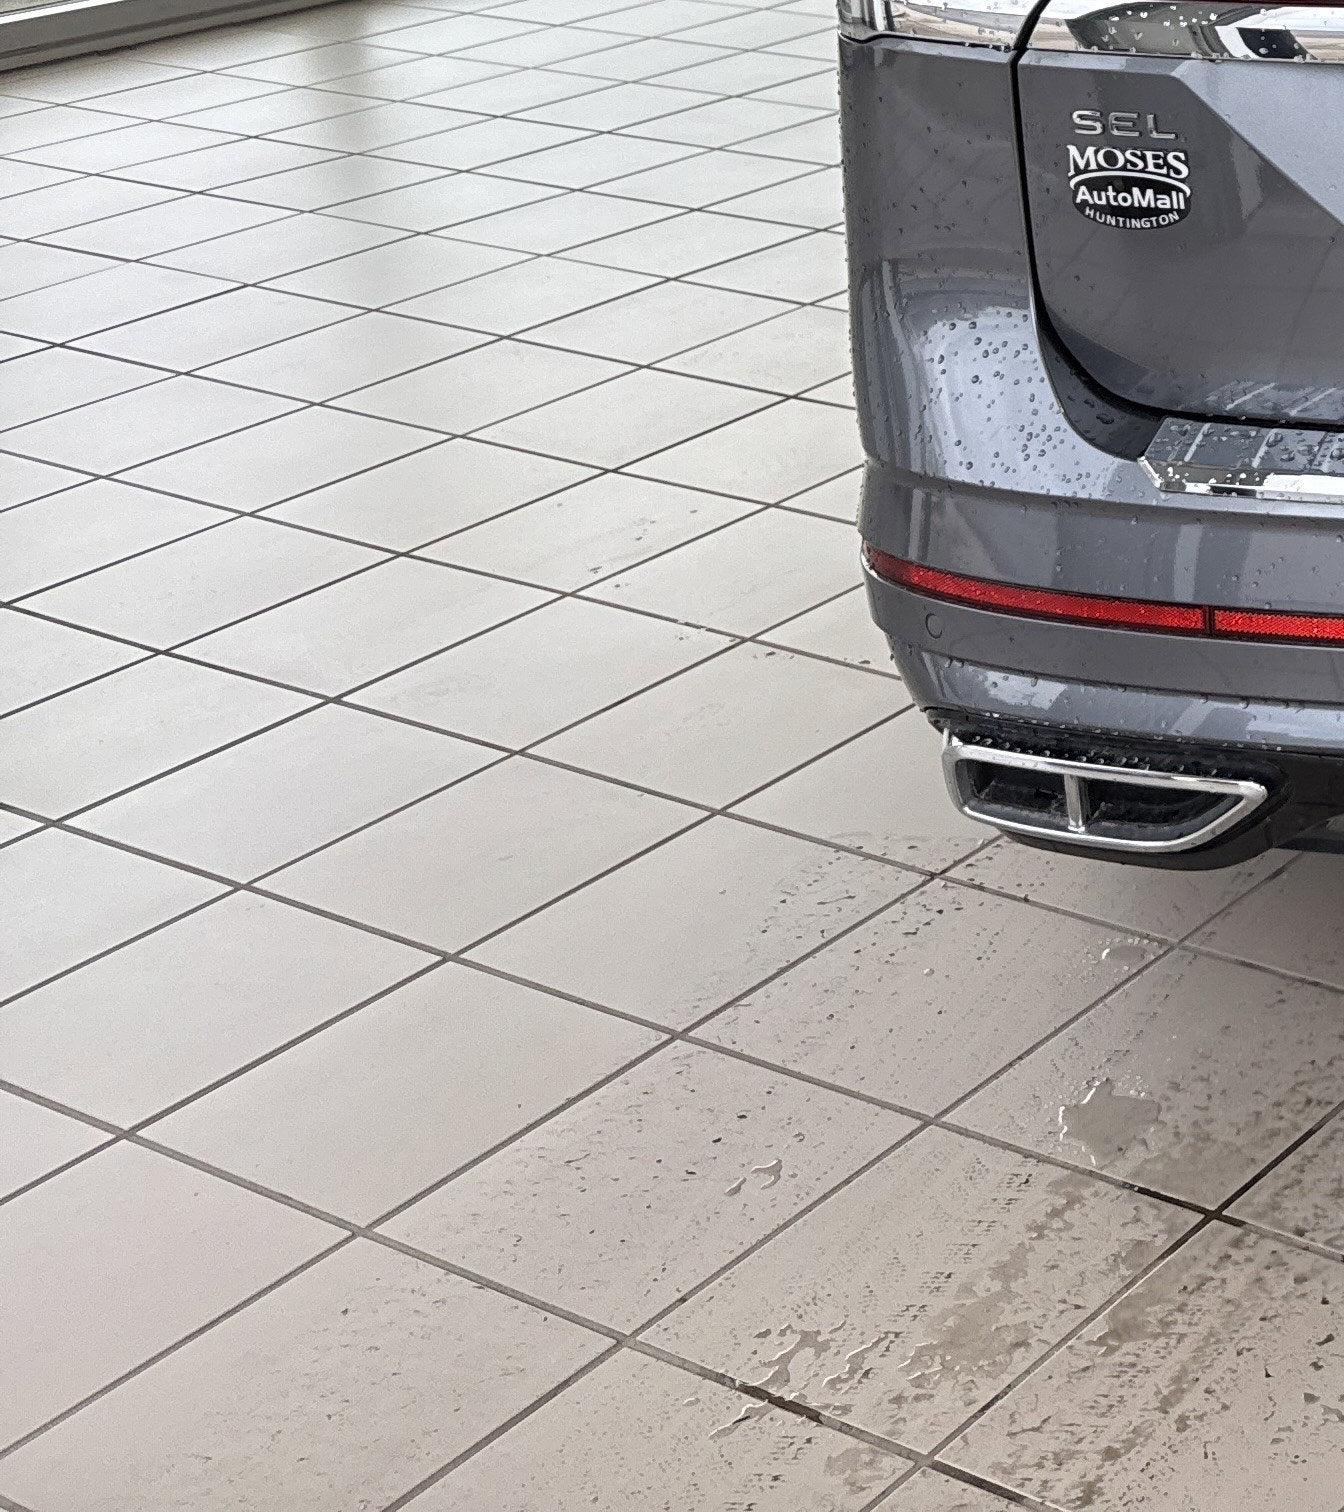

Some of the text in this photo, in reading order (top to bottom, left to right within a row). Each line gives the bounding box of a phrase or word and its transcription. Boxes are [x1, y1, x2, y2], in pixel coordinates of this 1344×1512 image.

[1072, 110, 1177, 139] SEL
[1066, 144, 1189, 179] MOSES
[1076, 185, 1186, 209] AutoMall
[1085, 206, 1180, 228] HUNTINGTON
